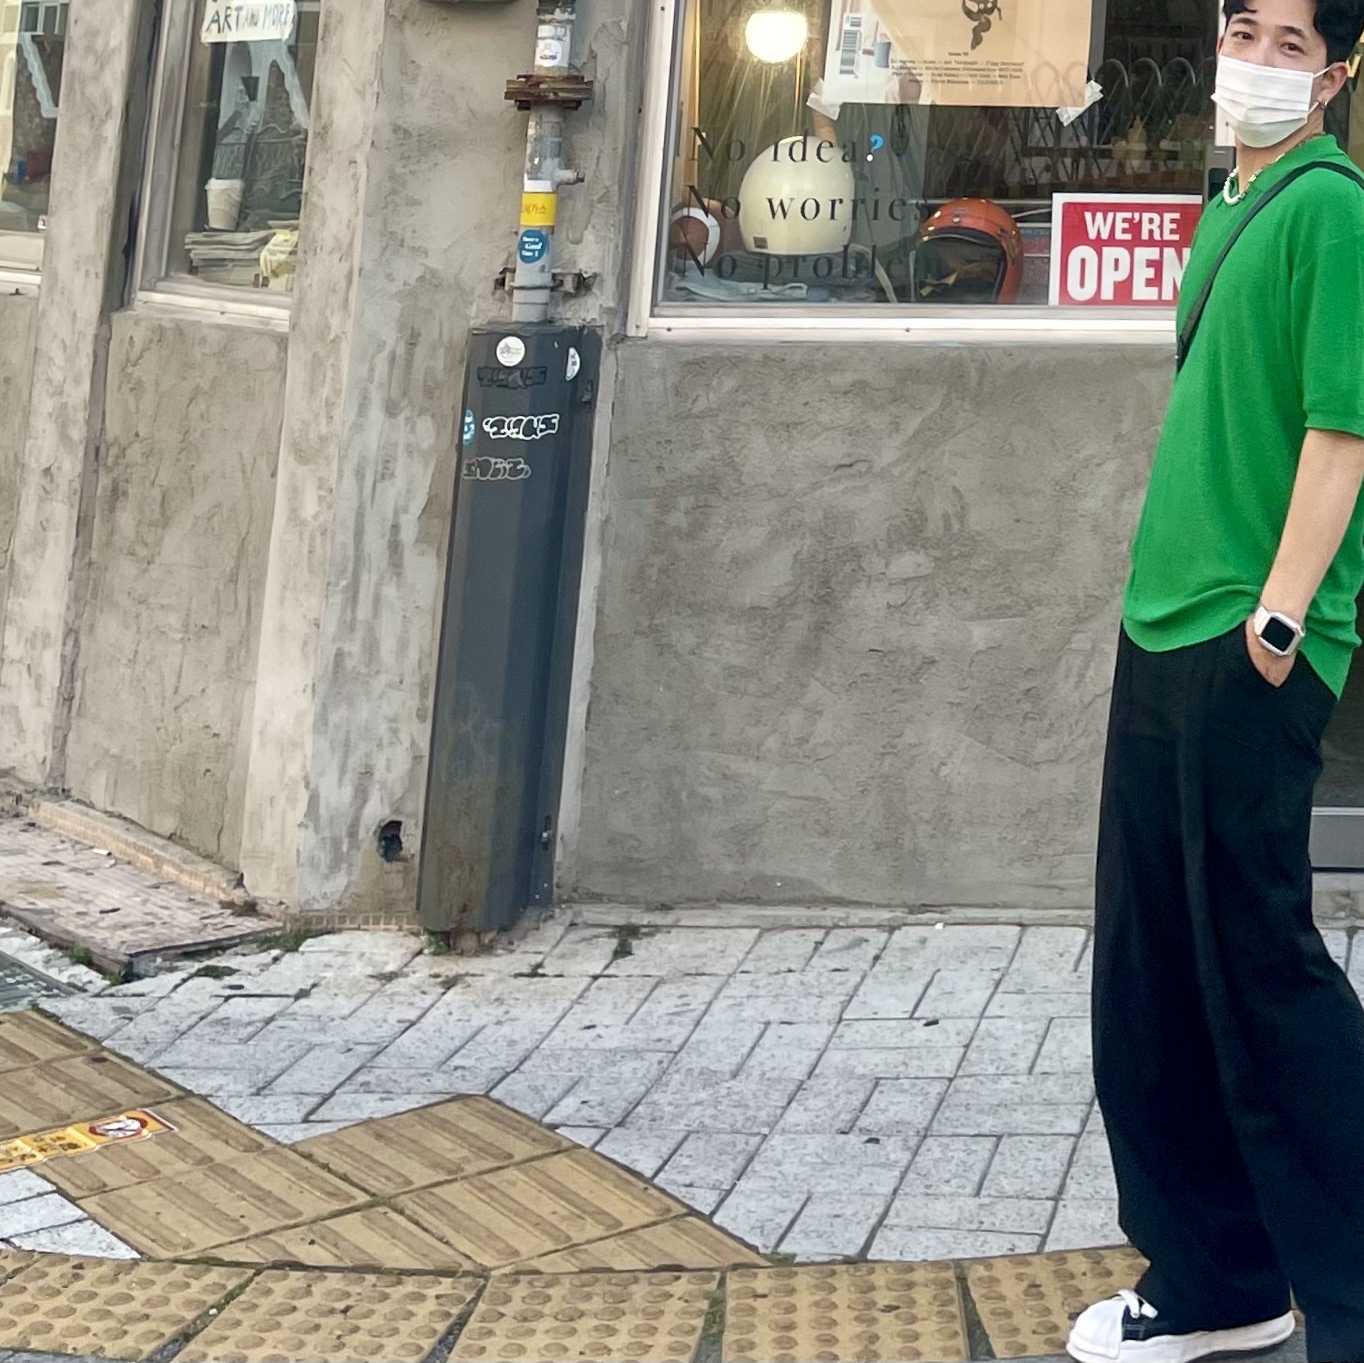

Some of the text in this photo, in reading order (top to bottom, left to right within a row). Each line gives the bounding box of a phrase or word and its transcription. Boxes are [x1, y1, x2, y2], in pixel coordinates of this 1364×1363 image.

[690, 127, 746, 162] No
[687, 185, 928, 222] No worries
[1084, 211, 1181, 241] WE'RE
[674, 240, 738, 278] No
[1066, 244, 1191, 302] OPEN
